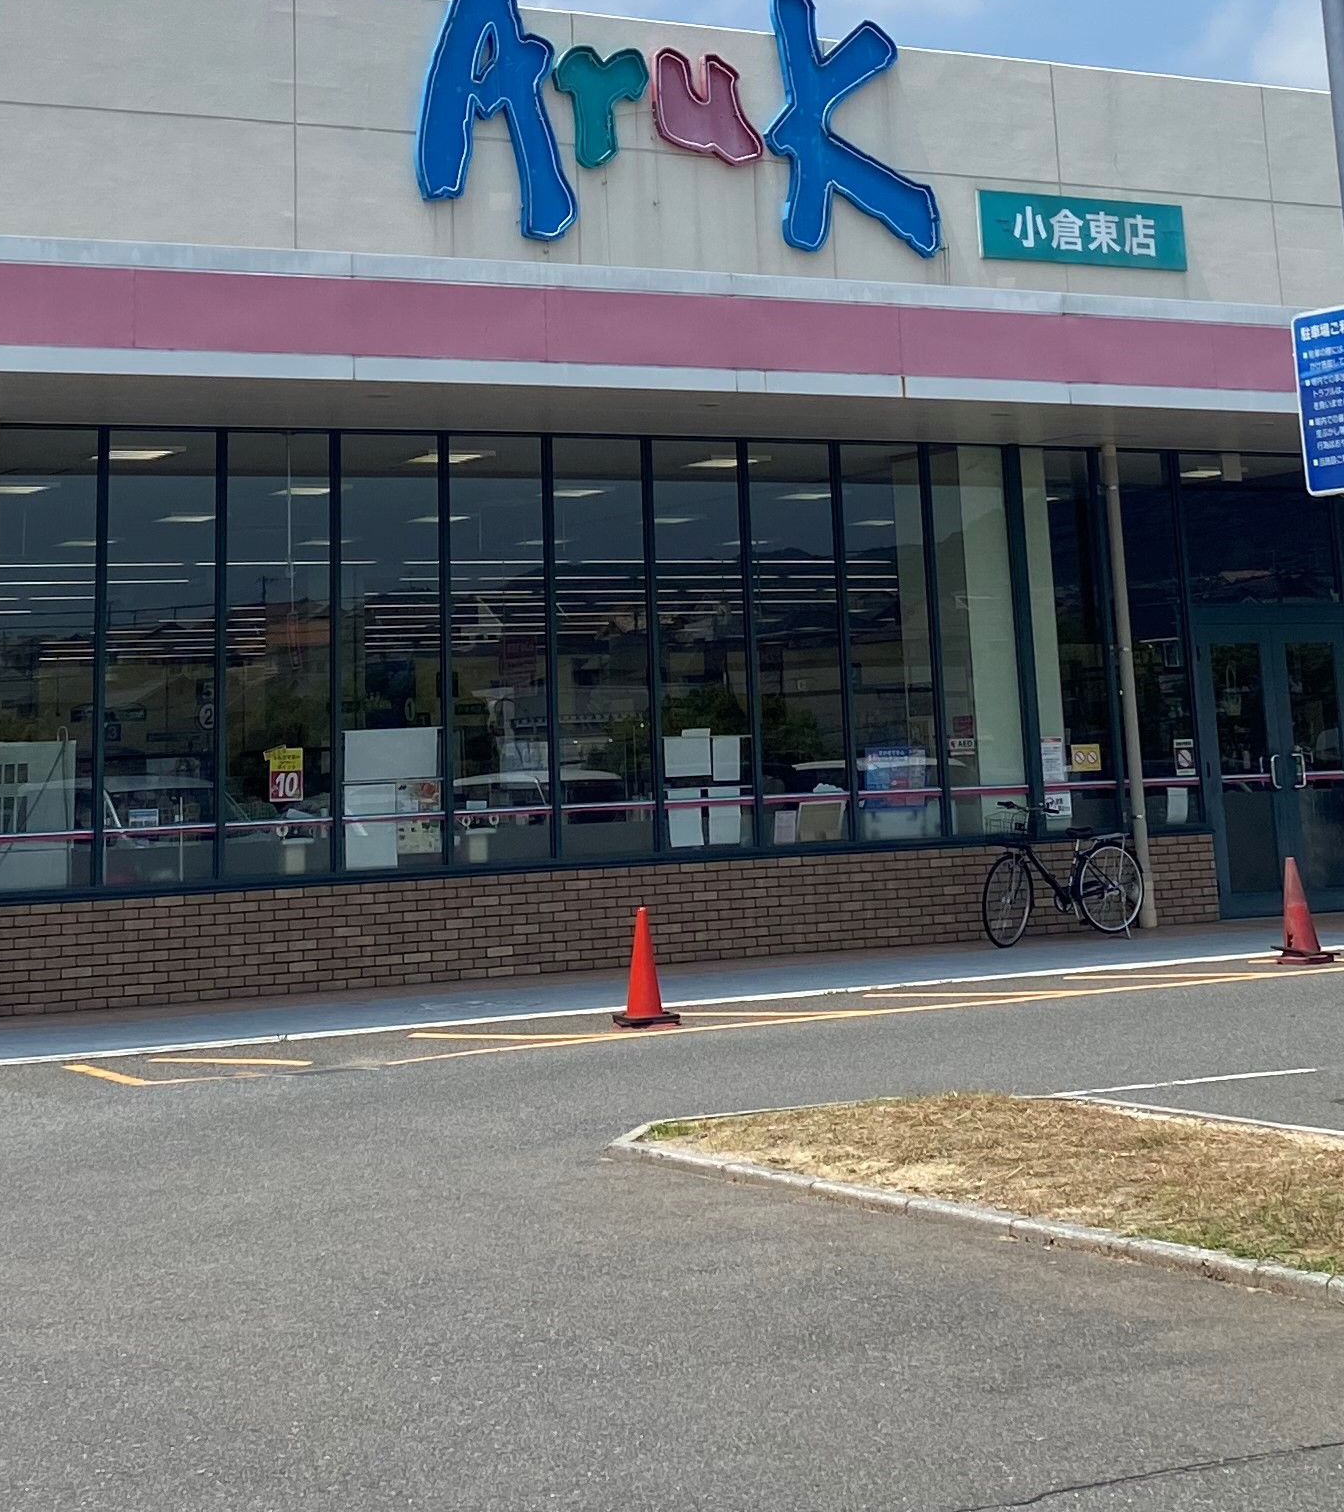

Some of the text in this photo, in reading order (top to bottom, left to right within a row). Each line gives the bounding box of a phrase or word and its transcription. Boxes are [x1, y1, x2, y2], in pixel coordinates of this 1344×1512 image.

[1013, 205, 1157, 258] 小倉東店
[204, 708, 213, 725] 2
[276, 772, 299, 797] 10
